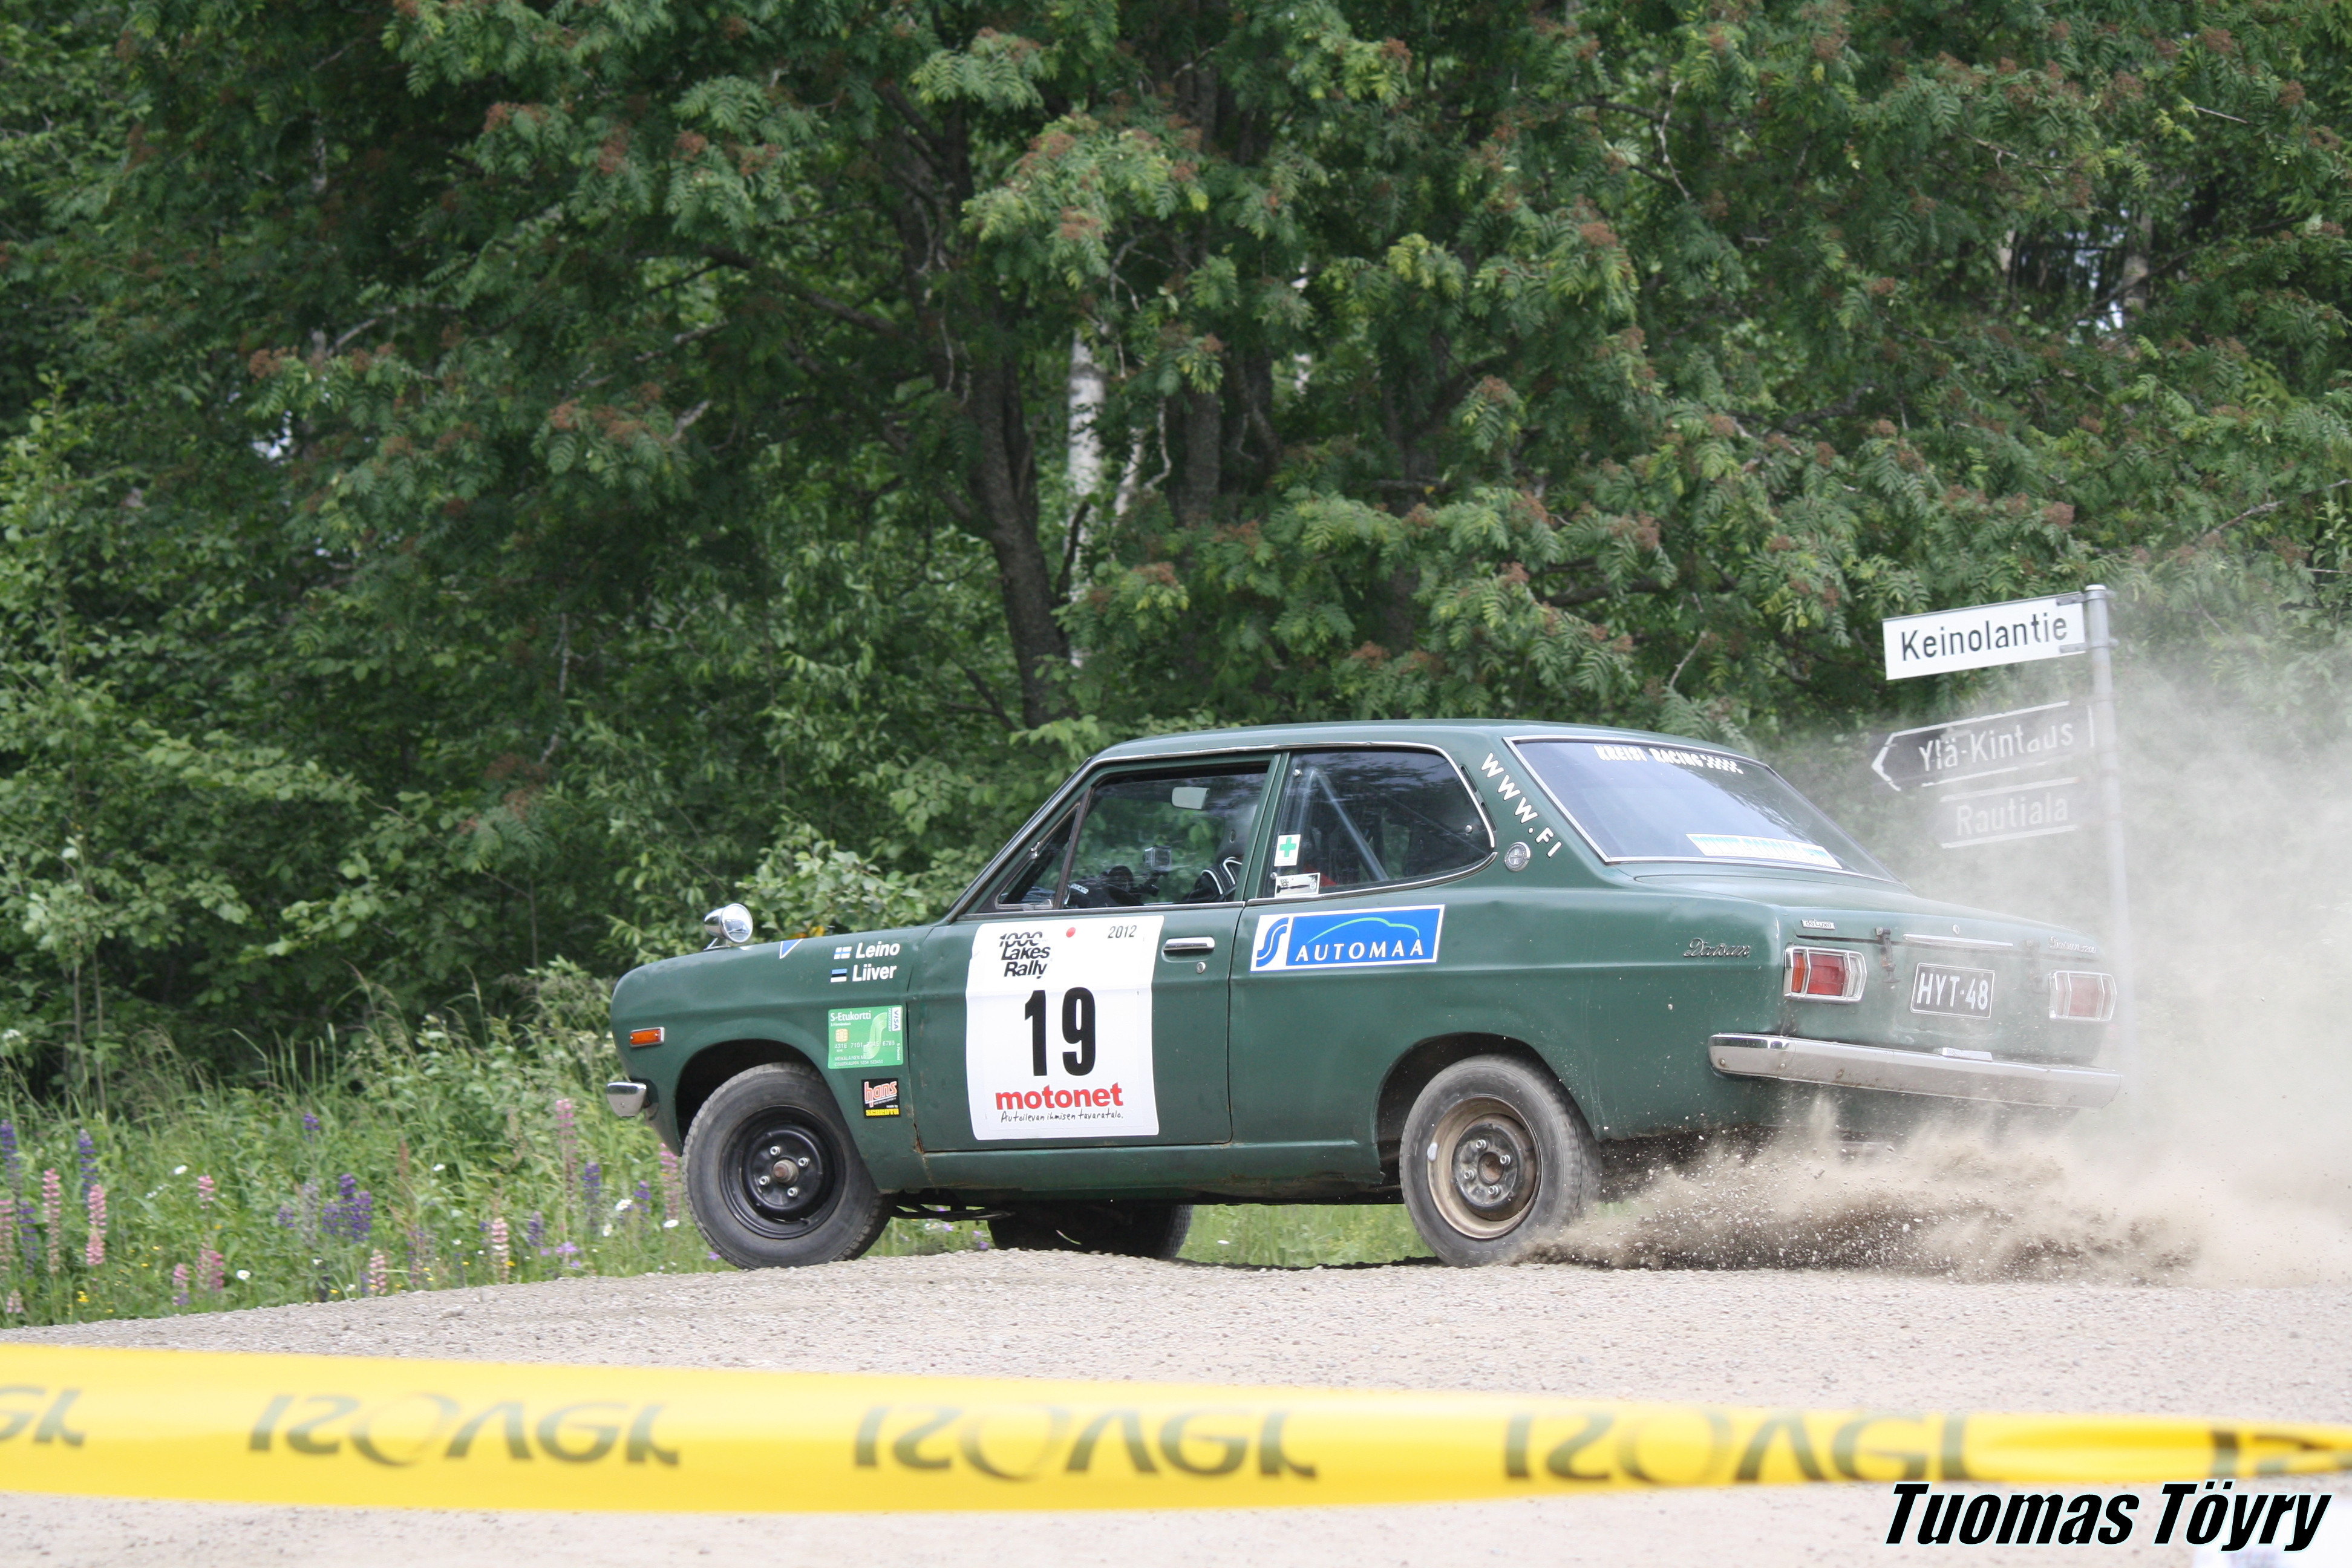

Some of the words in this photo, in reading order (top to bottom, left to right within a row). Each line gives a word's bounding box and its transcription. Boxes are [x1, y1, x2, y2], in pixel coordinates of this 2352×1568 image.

[1901, 612, 2068, 661] Keinolantie
[1648, 748, 1704, 767] RACING
[1918, 722, 2074, 772] Ylä-Kintaus
[1956, 792, 2069, 836] Rautiala
[1108, 925, 1137, 939] 2012
[855, 941, 900, 959] Leino
[1001, 945, 1051, 961] Lakes
[1295, 939, 1423, 962] AUTOMAA
[852, 964, 897, 982] Liiver
[1004, 959, 1048, 979] Rally
[1916, 972, 1989, 1010] HYT-48
[830, 1010, 872, 1022] S-Etukortti
[1025, 987, 1096, 1076] 19
[864, 1080, 898, 1108] hans
[995, 1082, 1123, 1110] motonet
[1001, 1111, 1045, 1123] Autoilevan
[1047, 1112, 1076, 1121] ihmisen
[1077, 1108, 1124, 1120] tavaratalo.
